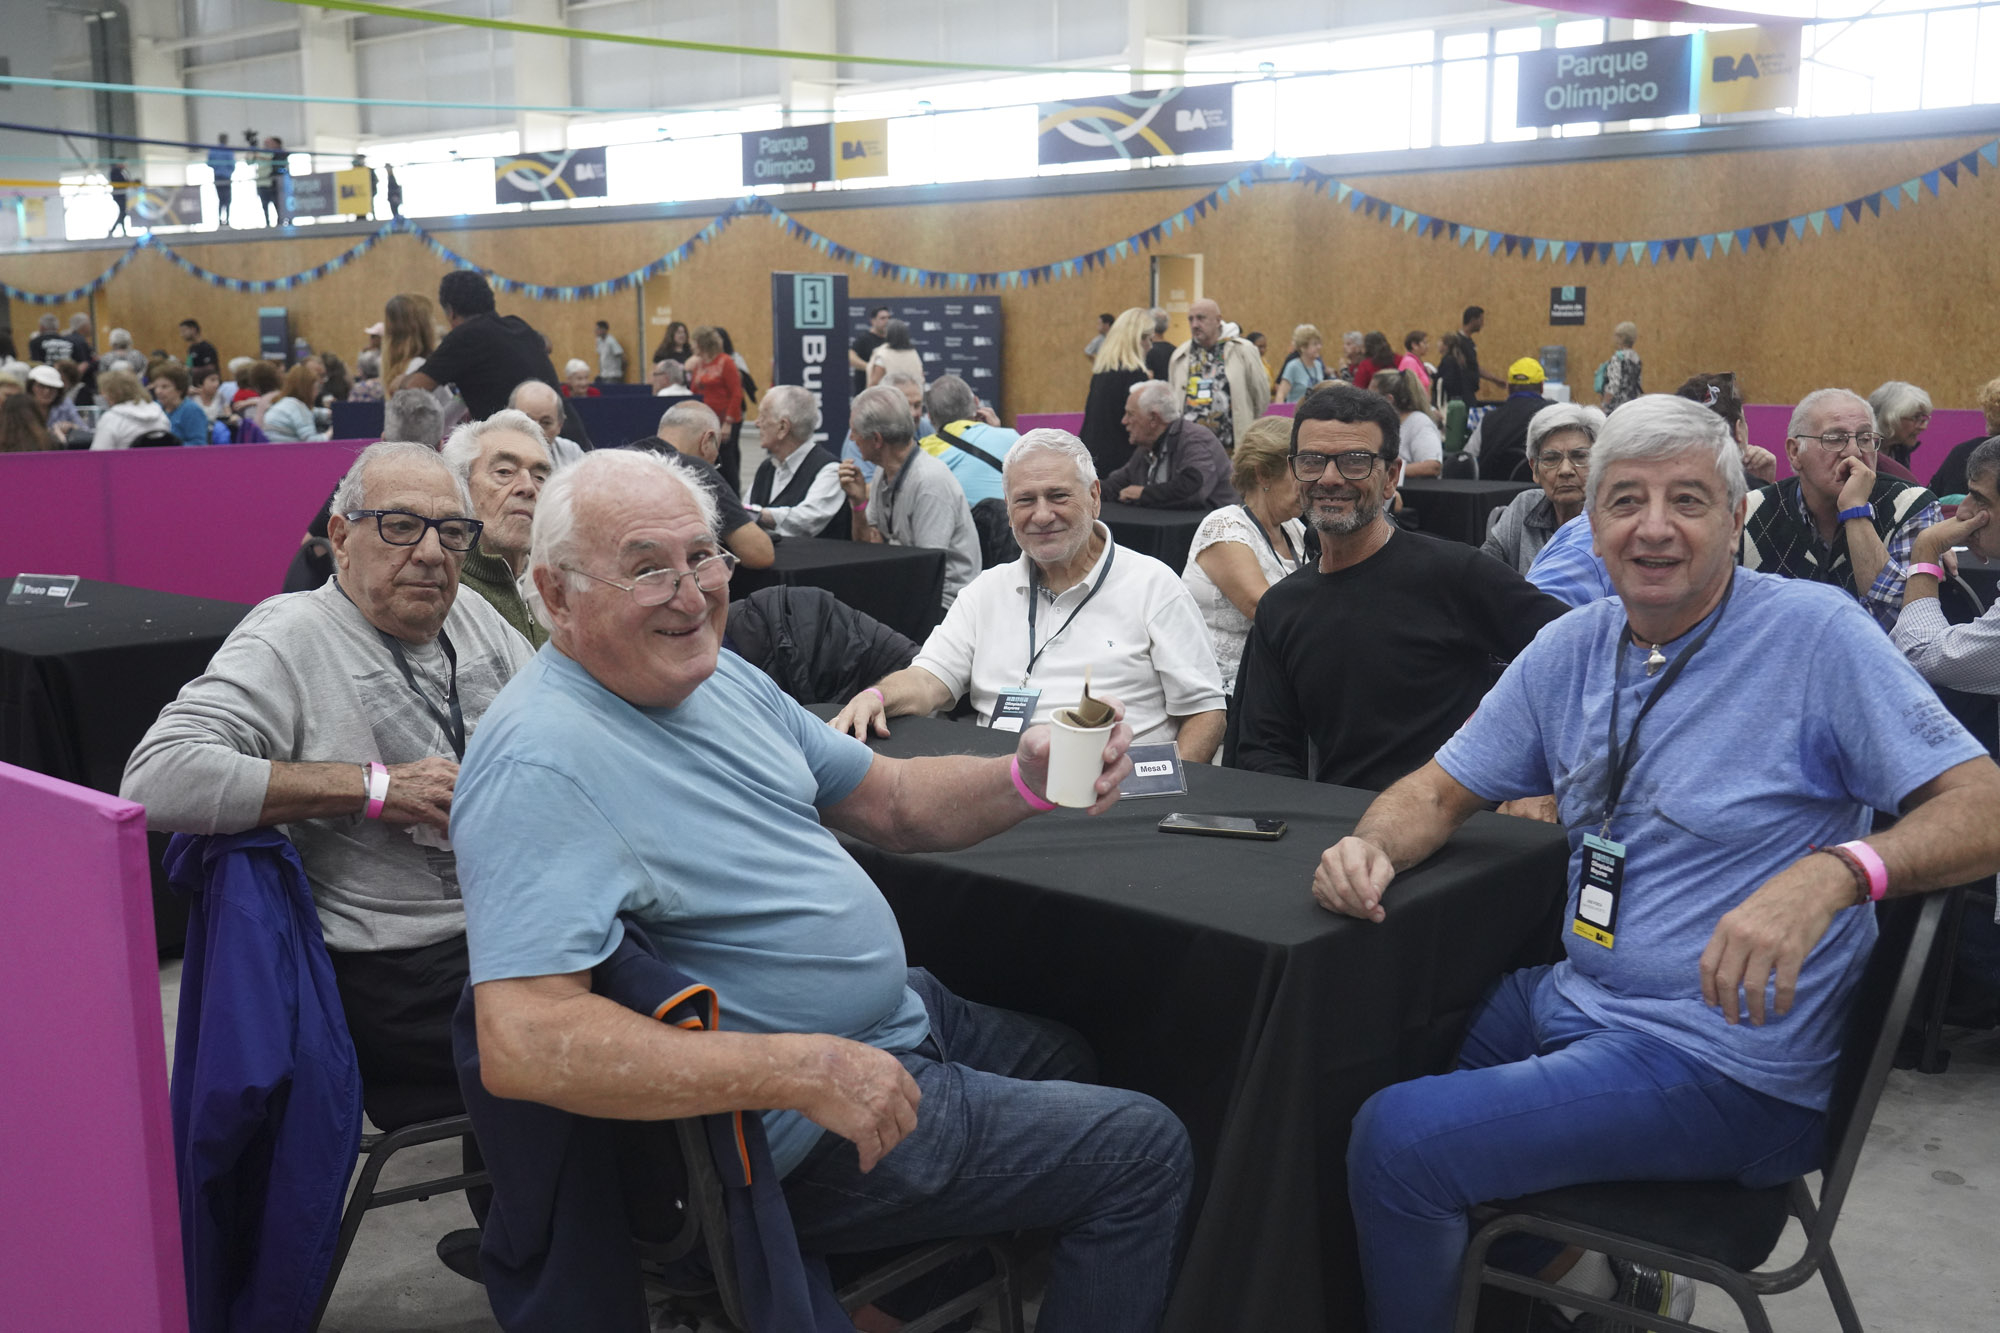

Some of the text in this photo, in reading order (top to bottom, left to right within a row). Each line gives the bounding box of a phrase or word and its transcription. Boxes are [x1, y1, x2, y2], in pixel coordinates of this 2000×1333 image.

[1557, 50, 1648, 78] Parque
[1712, 53, 1759, 82] BA
[1544, 79, 1658, 111] Olímpico
[758, 136, 809, 156] Parque
[1140, 765, 1161, 773] Mesa
